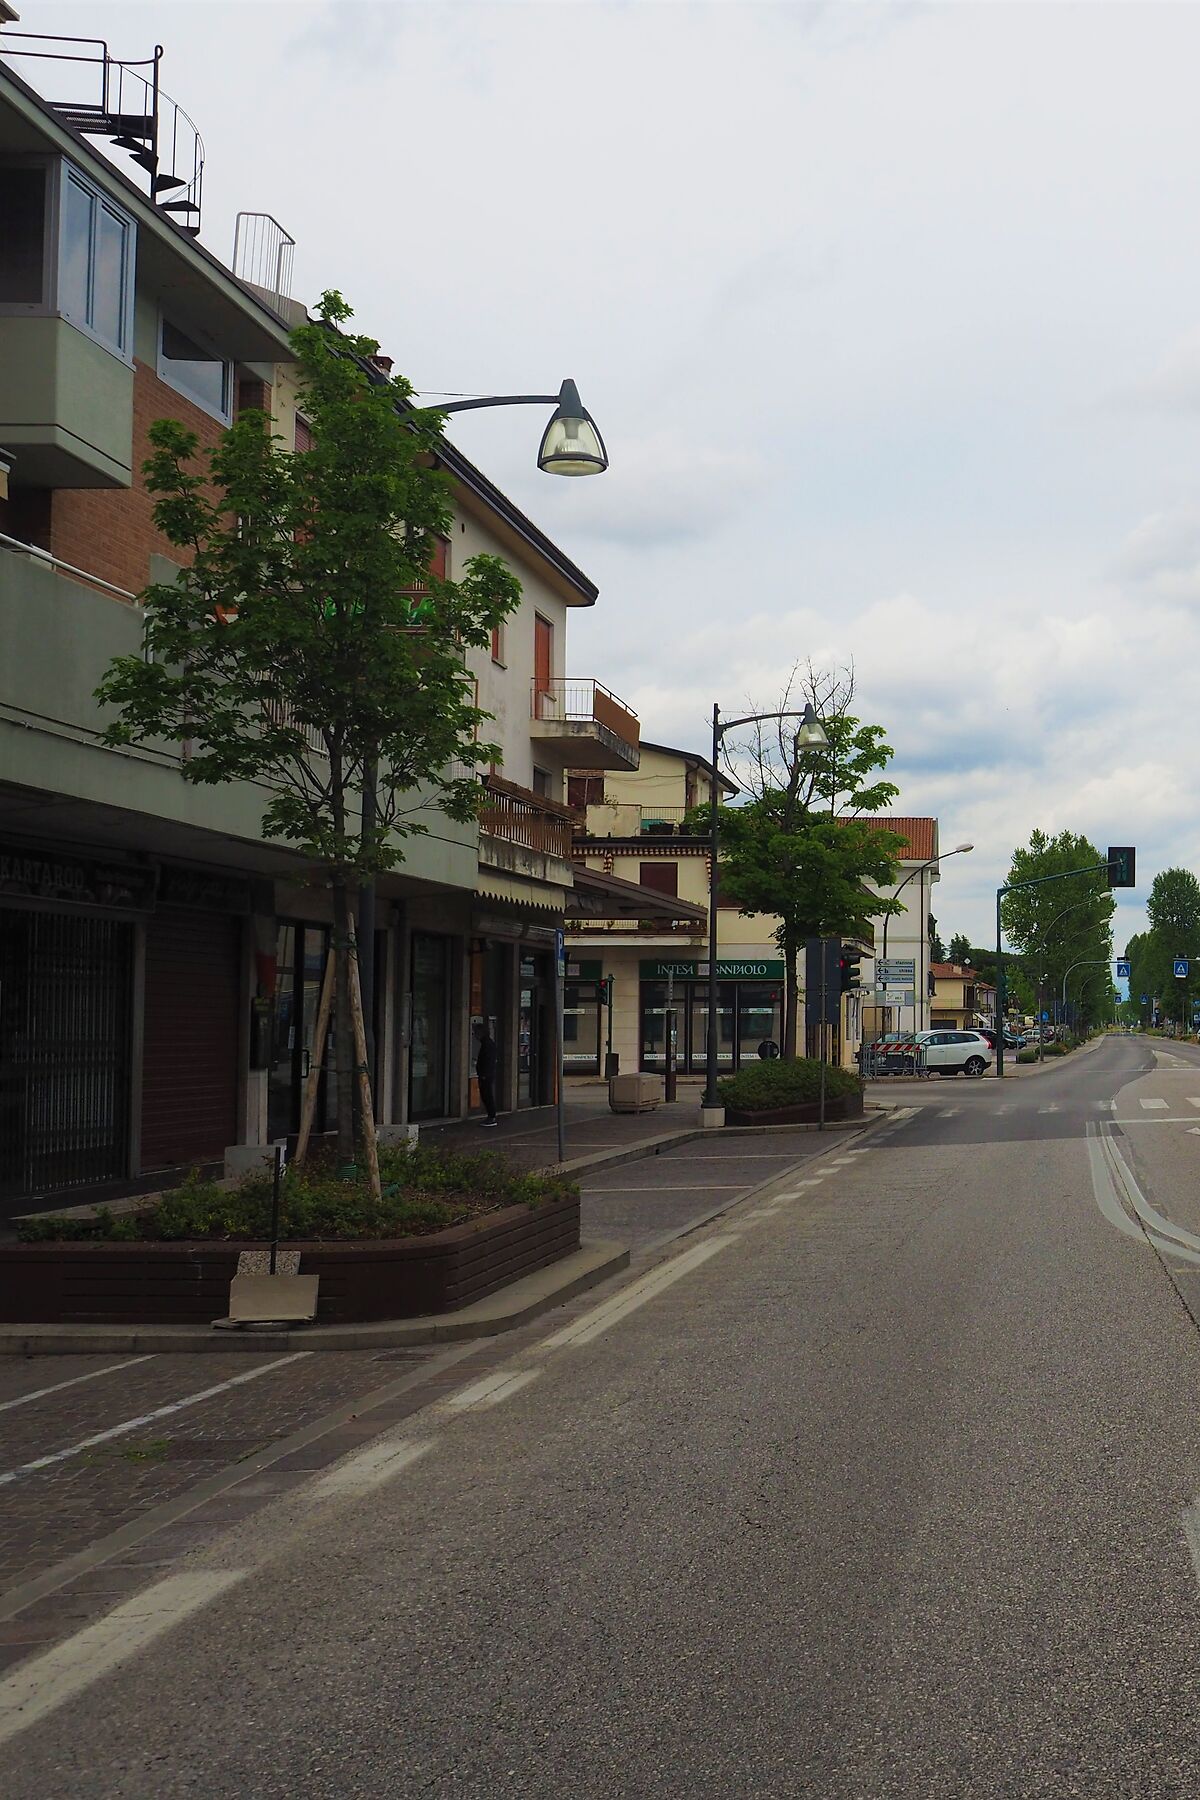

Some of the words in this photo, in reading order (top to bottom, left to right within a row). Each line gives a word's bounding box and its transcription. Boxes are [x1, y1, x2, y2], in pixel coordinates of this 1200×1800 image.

[558, 932, 563, 957] P
[657, 964, 694, 975] INTESA
[715, 964, 767, 975] SANPAOLO
